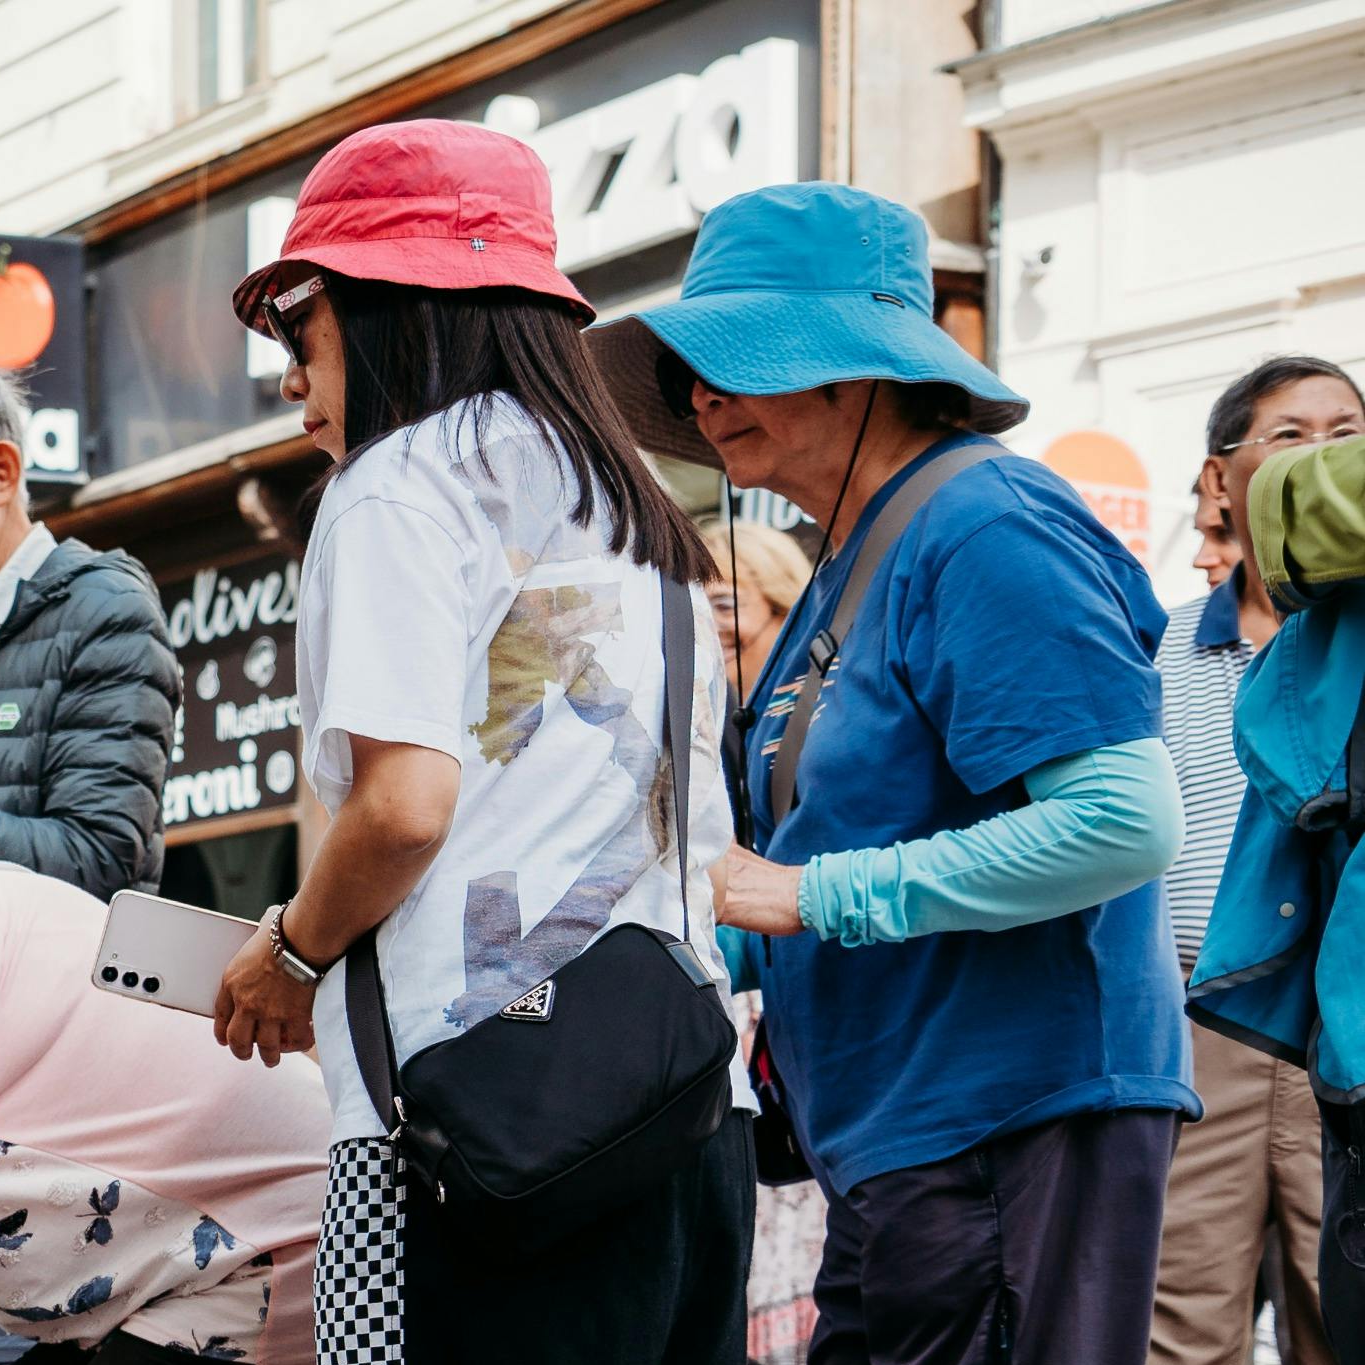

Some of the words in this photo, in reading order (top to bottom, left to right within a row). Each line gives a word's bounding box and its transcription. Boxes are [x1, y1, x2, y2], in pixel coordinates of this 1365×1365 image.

[485, 38, 800, 268] zza
[170, 560, 299, 648] olives
[513, 988, 547, 1011] PRADA
